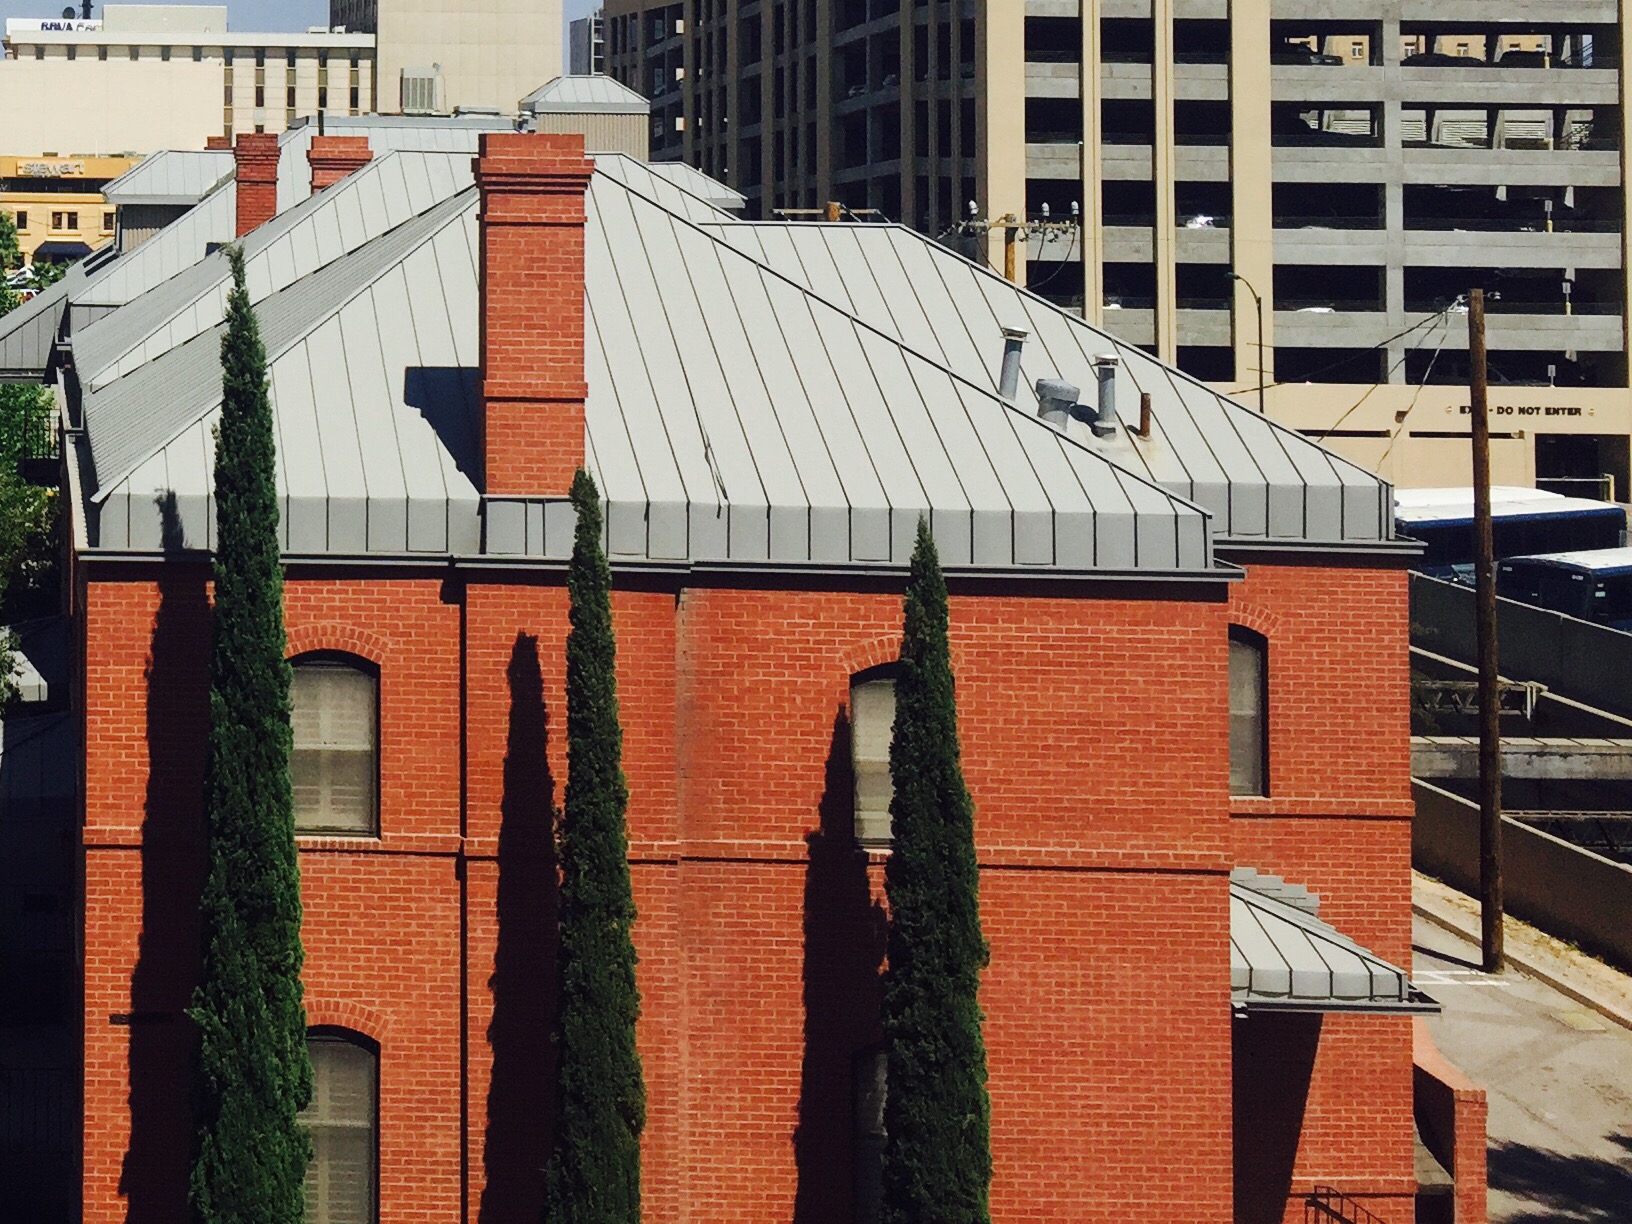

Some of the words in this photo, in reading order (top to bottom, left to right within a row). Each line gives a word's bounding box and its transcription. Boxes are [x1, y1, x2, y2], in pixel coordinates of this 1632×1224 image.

[1496, 406, 1514, 416] DO
[1518, 406, 1541, 416] NOT
[1545, 407, 1582, 417] ENTER
